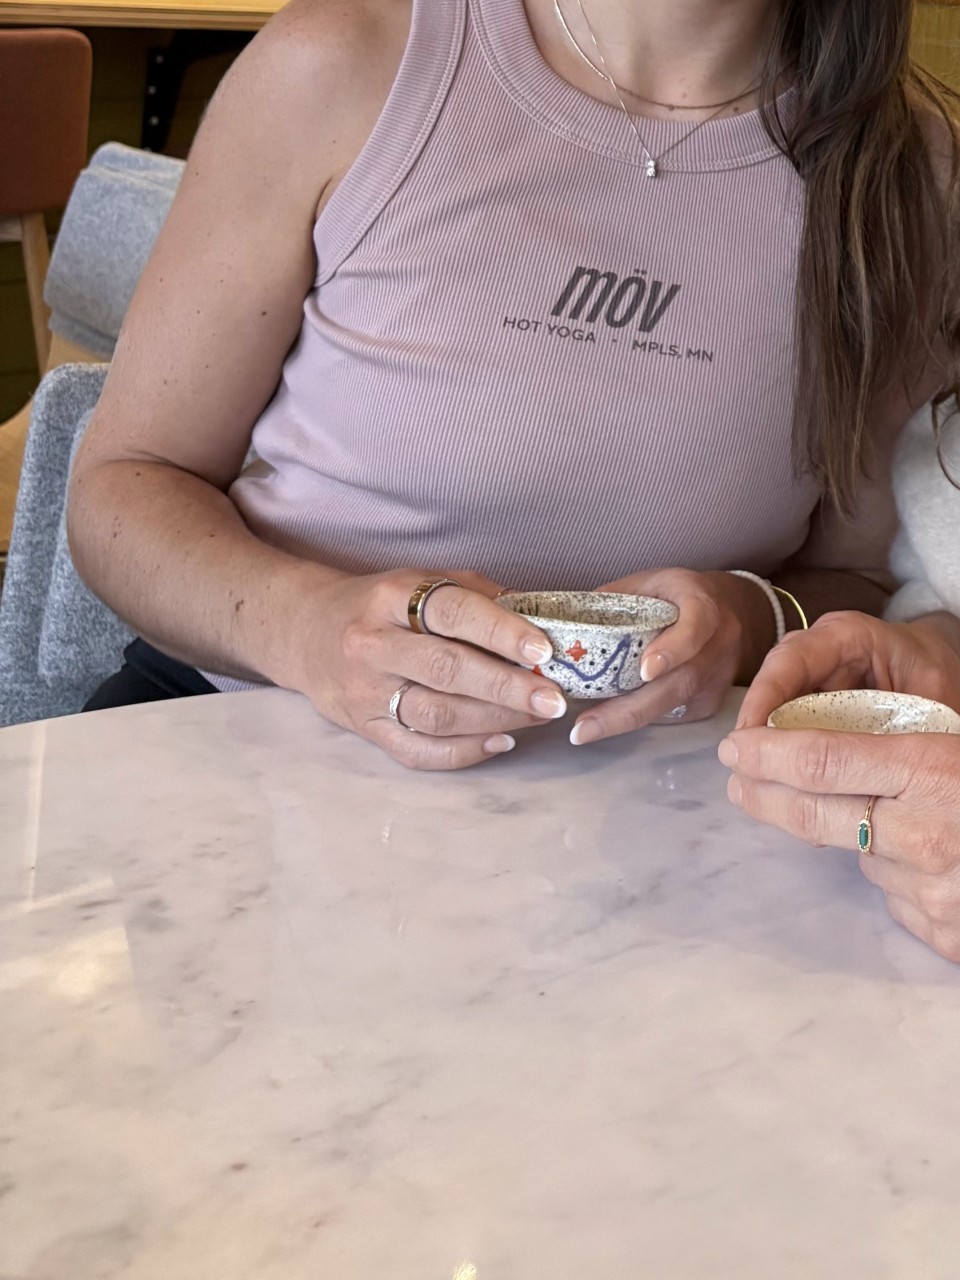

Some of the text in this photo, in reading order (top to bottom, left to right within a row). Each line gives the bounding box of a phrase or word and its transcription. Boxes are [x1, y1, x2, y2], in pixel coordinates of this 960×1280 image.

[503, 316, 542, 333] HOT
[547, 323, 596, 344] YOGA
[632, 340, 682, 359] MPLS,
[687, 347, 714, 362] MN
